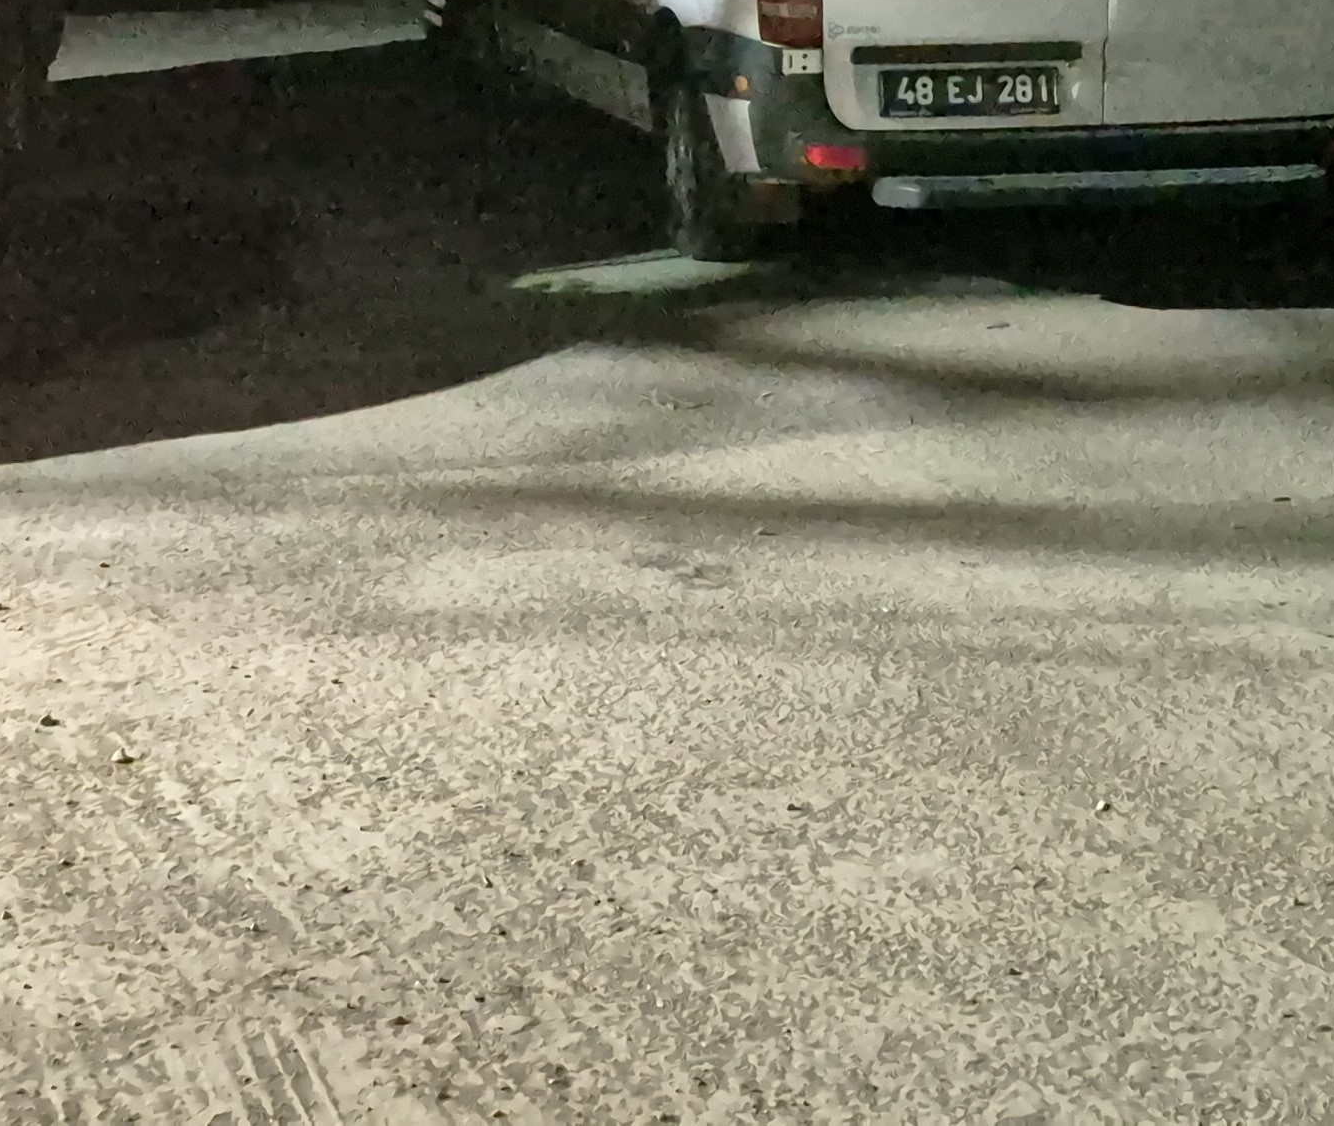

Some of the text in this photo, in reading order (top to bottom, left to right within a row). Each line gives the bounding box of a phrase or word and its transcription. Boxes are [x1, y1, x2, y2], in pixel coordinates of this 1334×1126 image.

[898, 75, 1048, 105] 48 EJ 281
